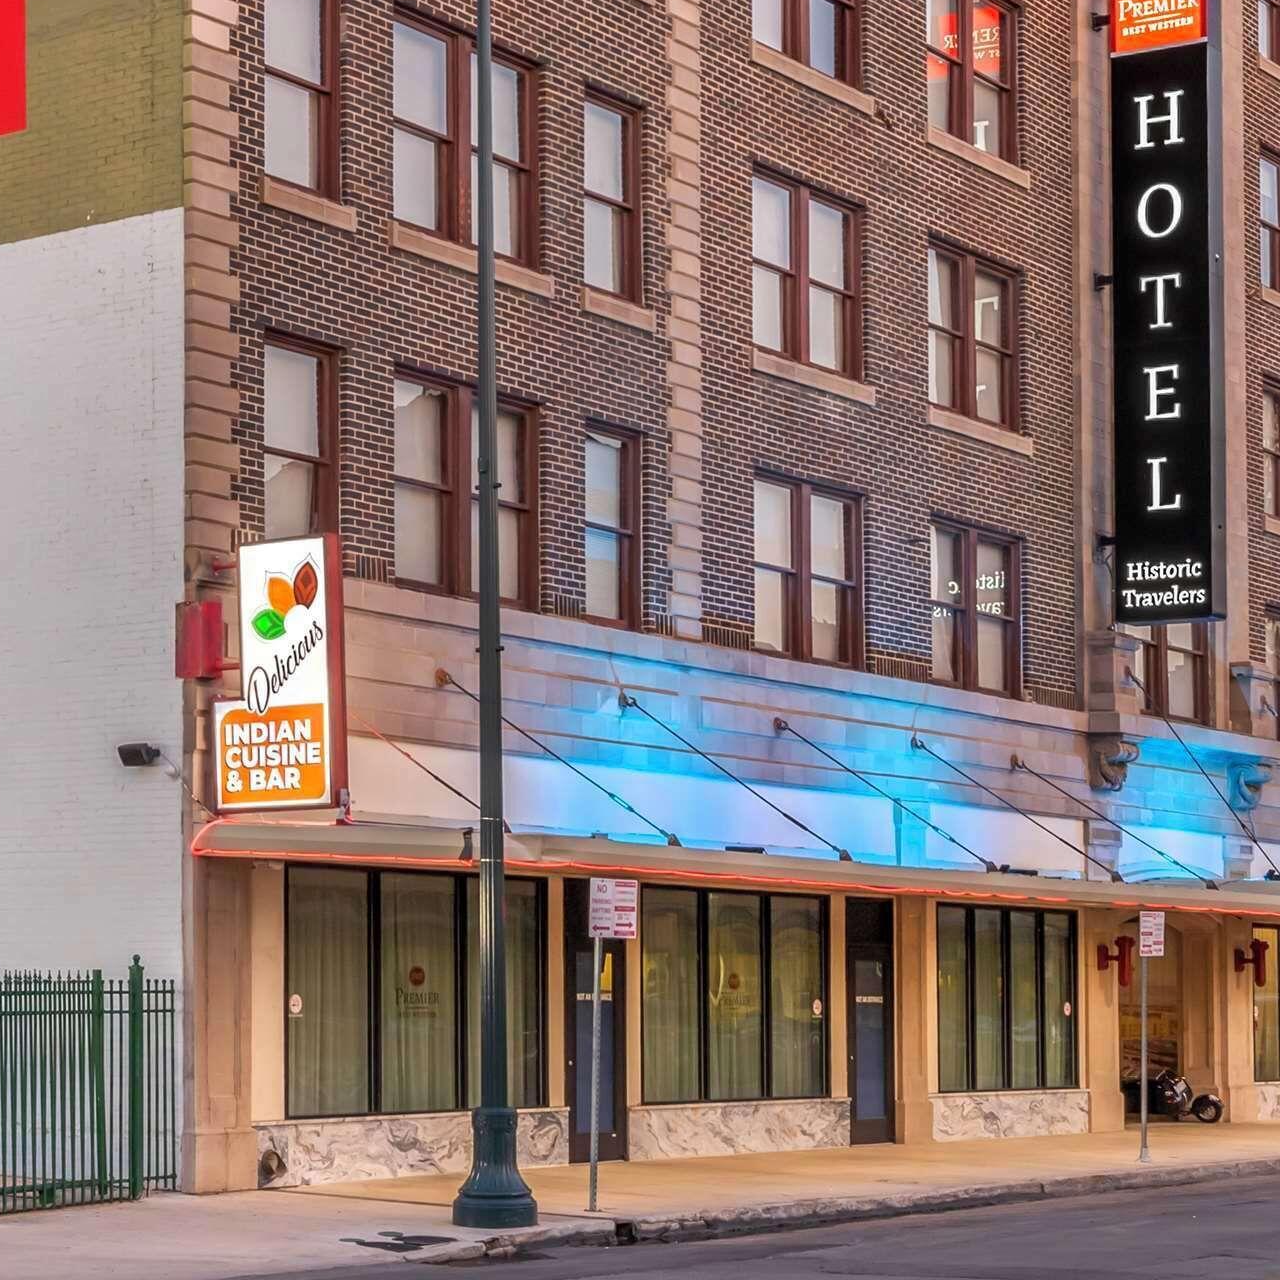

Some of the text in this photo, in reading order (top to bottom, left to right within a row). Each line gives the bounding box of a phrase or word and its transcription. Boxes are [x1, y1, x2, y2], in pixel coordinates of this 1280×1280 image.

[1121, 16, 1194, 37] BEST WESTERN
[1133, 89, 1185, 511] HOTEL
[1126, 558, 1203, 582] Historic
[1122, 586, 1207, 609] Travelers
[247, 620, 324, 713] Delicious
[224, 719, 312, 745] INDIAN
[224, 742, 321, 769] CUISINE
[226, 767, 301, 792] & BAR
[597, 884, 608, 894] NO
